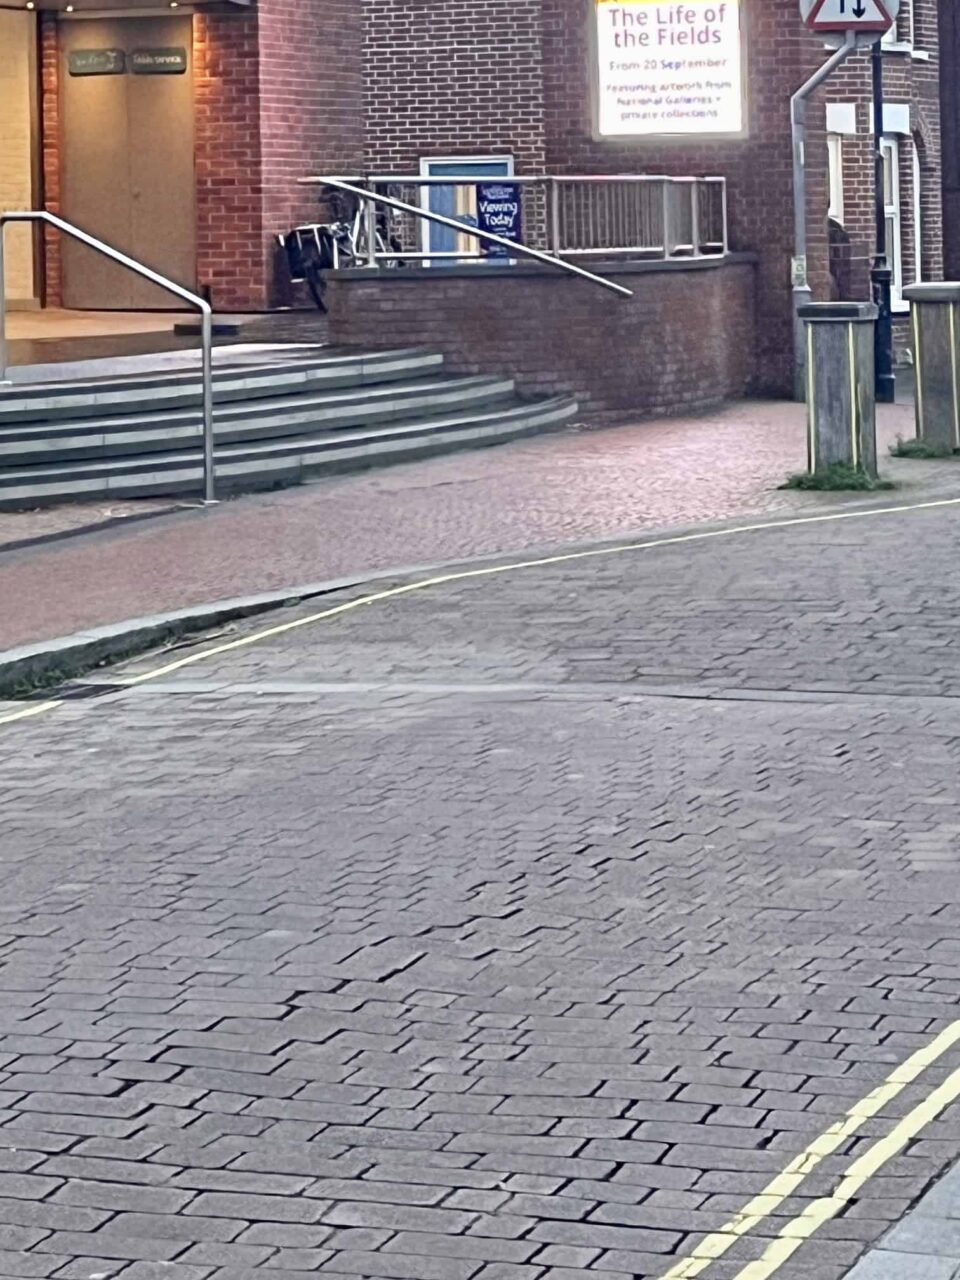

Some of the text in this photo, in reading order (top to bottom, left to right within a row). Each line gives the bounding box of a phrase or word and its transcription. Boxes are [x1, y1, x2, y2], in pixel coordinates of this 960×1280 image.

[608, 3, 726, 27] The Life of
[614, 25, 722, 48] the Fields
[609, 61, 640, 71] From
[661, 58, 728, 71] September
[484, 213, 514, 227] Today
